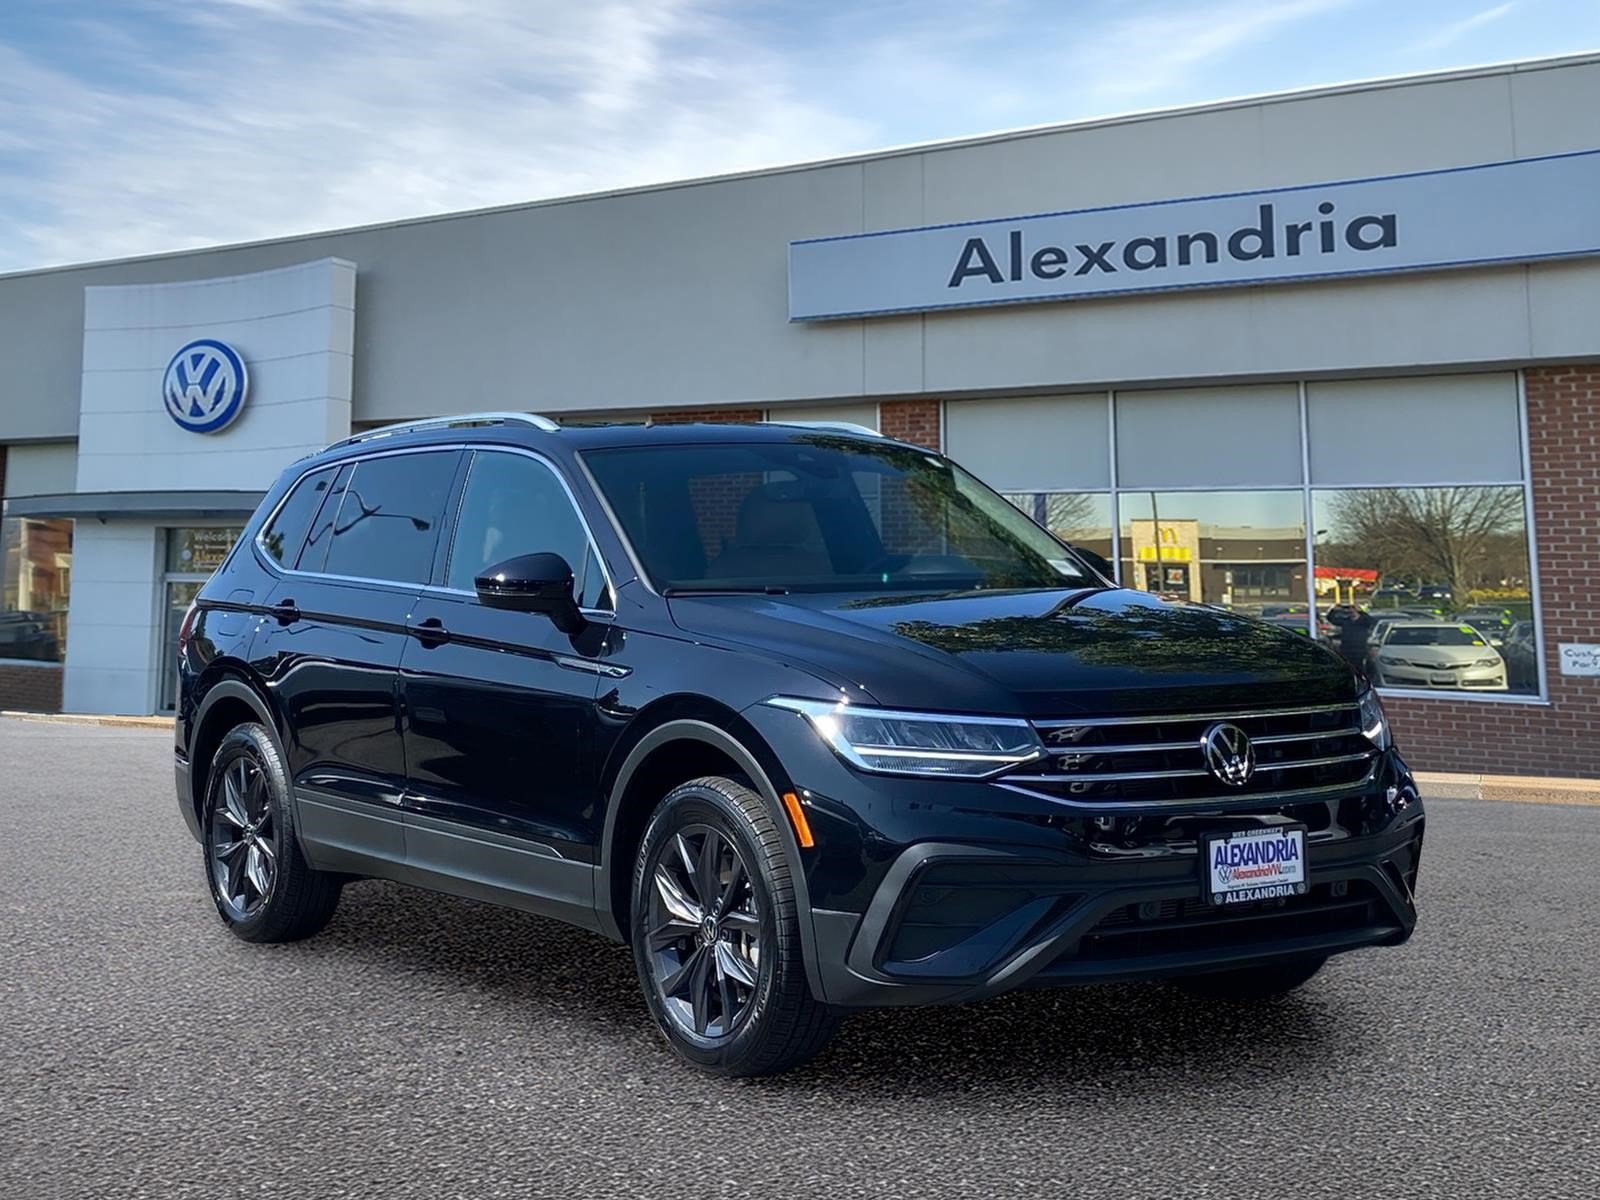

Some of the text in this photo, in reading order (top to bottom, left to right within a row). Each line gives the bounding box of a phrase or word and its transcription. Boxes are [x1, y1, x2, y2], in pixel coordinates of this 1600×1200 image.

[948, 202, 1398, 287] Alexandria
[1214, 838, 1299, 869] ALEXANDRIA
[1225, 884, 1295, 904] ALEXANDRIA
